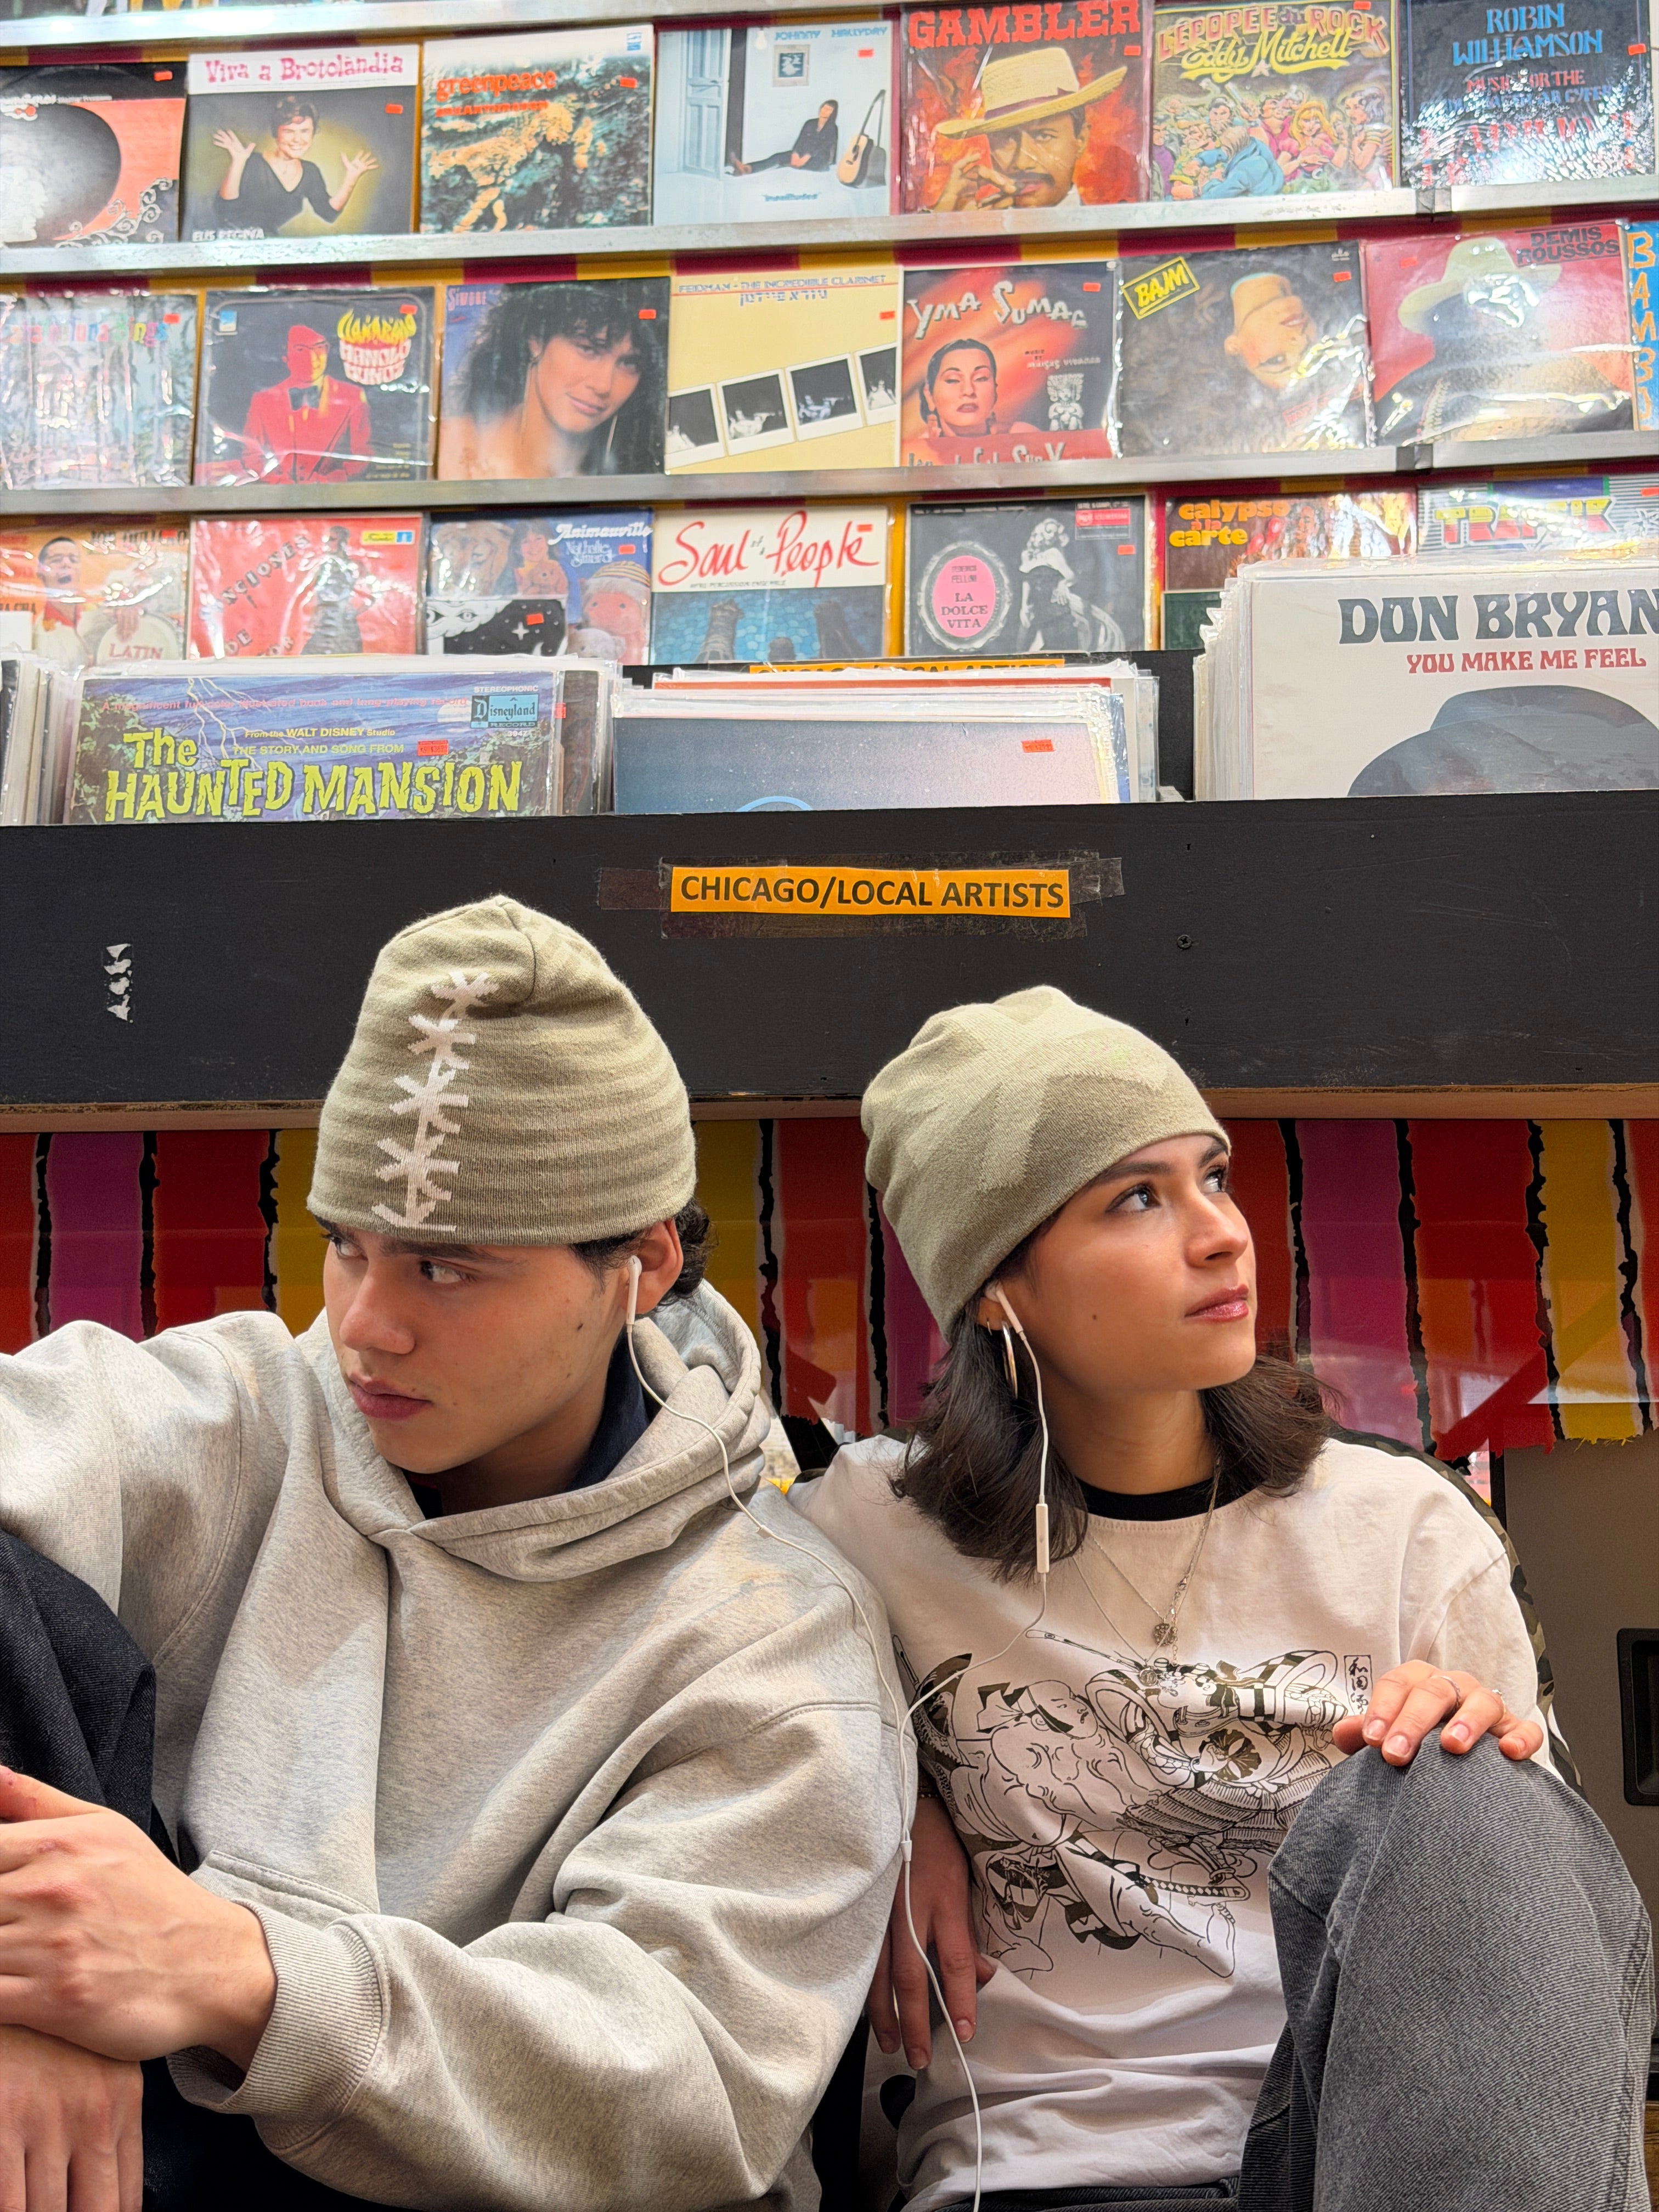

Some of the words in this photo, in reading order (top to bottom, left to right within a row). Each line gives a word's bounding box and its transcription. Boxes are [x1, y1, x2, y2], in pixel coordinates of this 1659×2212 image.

[908, 0, 1140, 49] GAMBLER
[1306, 5, 1390, 53] ROCK
[1487, 3, 1565, 34] ROBIN
[1181, 38, 1251, 83] Eddy
[1245, 26, 1350, 74] Mitchell
[1453, 29, 1602, 66] WILLIAMSON
[205, 60, 250, 83] Viva
[258, 65, 272, 81] a
[1467, 76, 1515, 93] MUSI
[1550, 70, 1585, 86] THE
[436, 71, 556, 102] greenpeace
[1531, 227, 1602, 247] DEMIS
[1516, 239, 1620, 264] ROUSSOS
[1178, 500, 1291, 522] calypso
[1169, 526, 1248, 547] carte
[1204, 519, 1222, 531] la
[658, 521, 752, 586] Soul
[766, 510, 880, 588] People
[955, 592, 973, 602] LA
[941, 605, 988, 616] DOLCE
[1338, 596, 1460, 645] DON
[947, 618, 981, 629] VITA
[109, 642, 163, 659] LATIN
[1406, 652, 1455, 674] YOU
[1461, 651, 1533, 672] MAKE
[1540, 650, 1578, 670] ME
[1584, 647, 1647, 668] FEEL
[473, 698, 535, 720] Disneyland
[286, 727, 319, 737] WALT
[320, 727, 365, 737] DISNEY
[123, 727, 199, 769] The
[232, 746, 256, 755] THE
[259, 745, 299, 755] STORY
[302, 744, 329, 754] AND
[331, 744, 366, 754] SONG
[369, 744, 404, 753] FROM
[105, 758, 294, 822] HAUNTED
[303, 760, 522, 816] MANSION
[681, 876, 933, 909] CHICAGO/LOCAL
[940, 882, 1064, 909] ARTISTS
